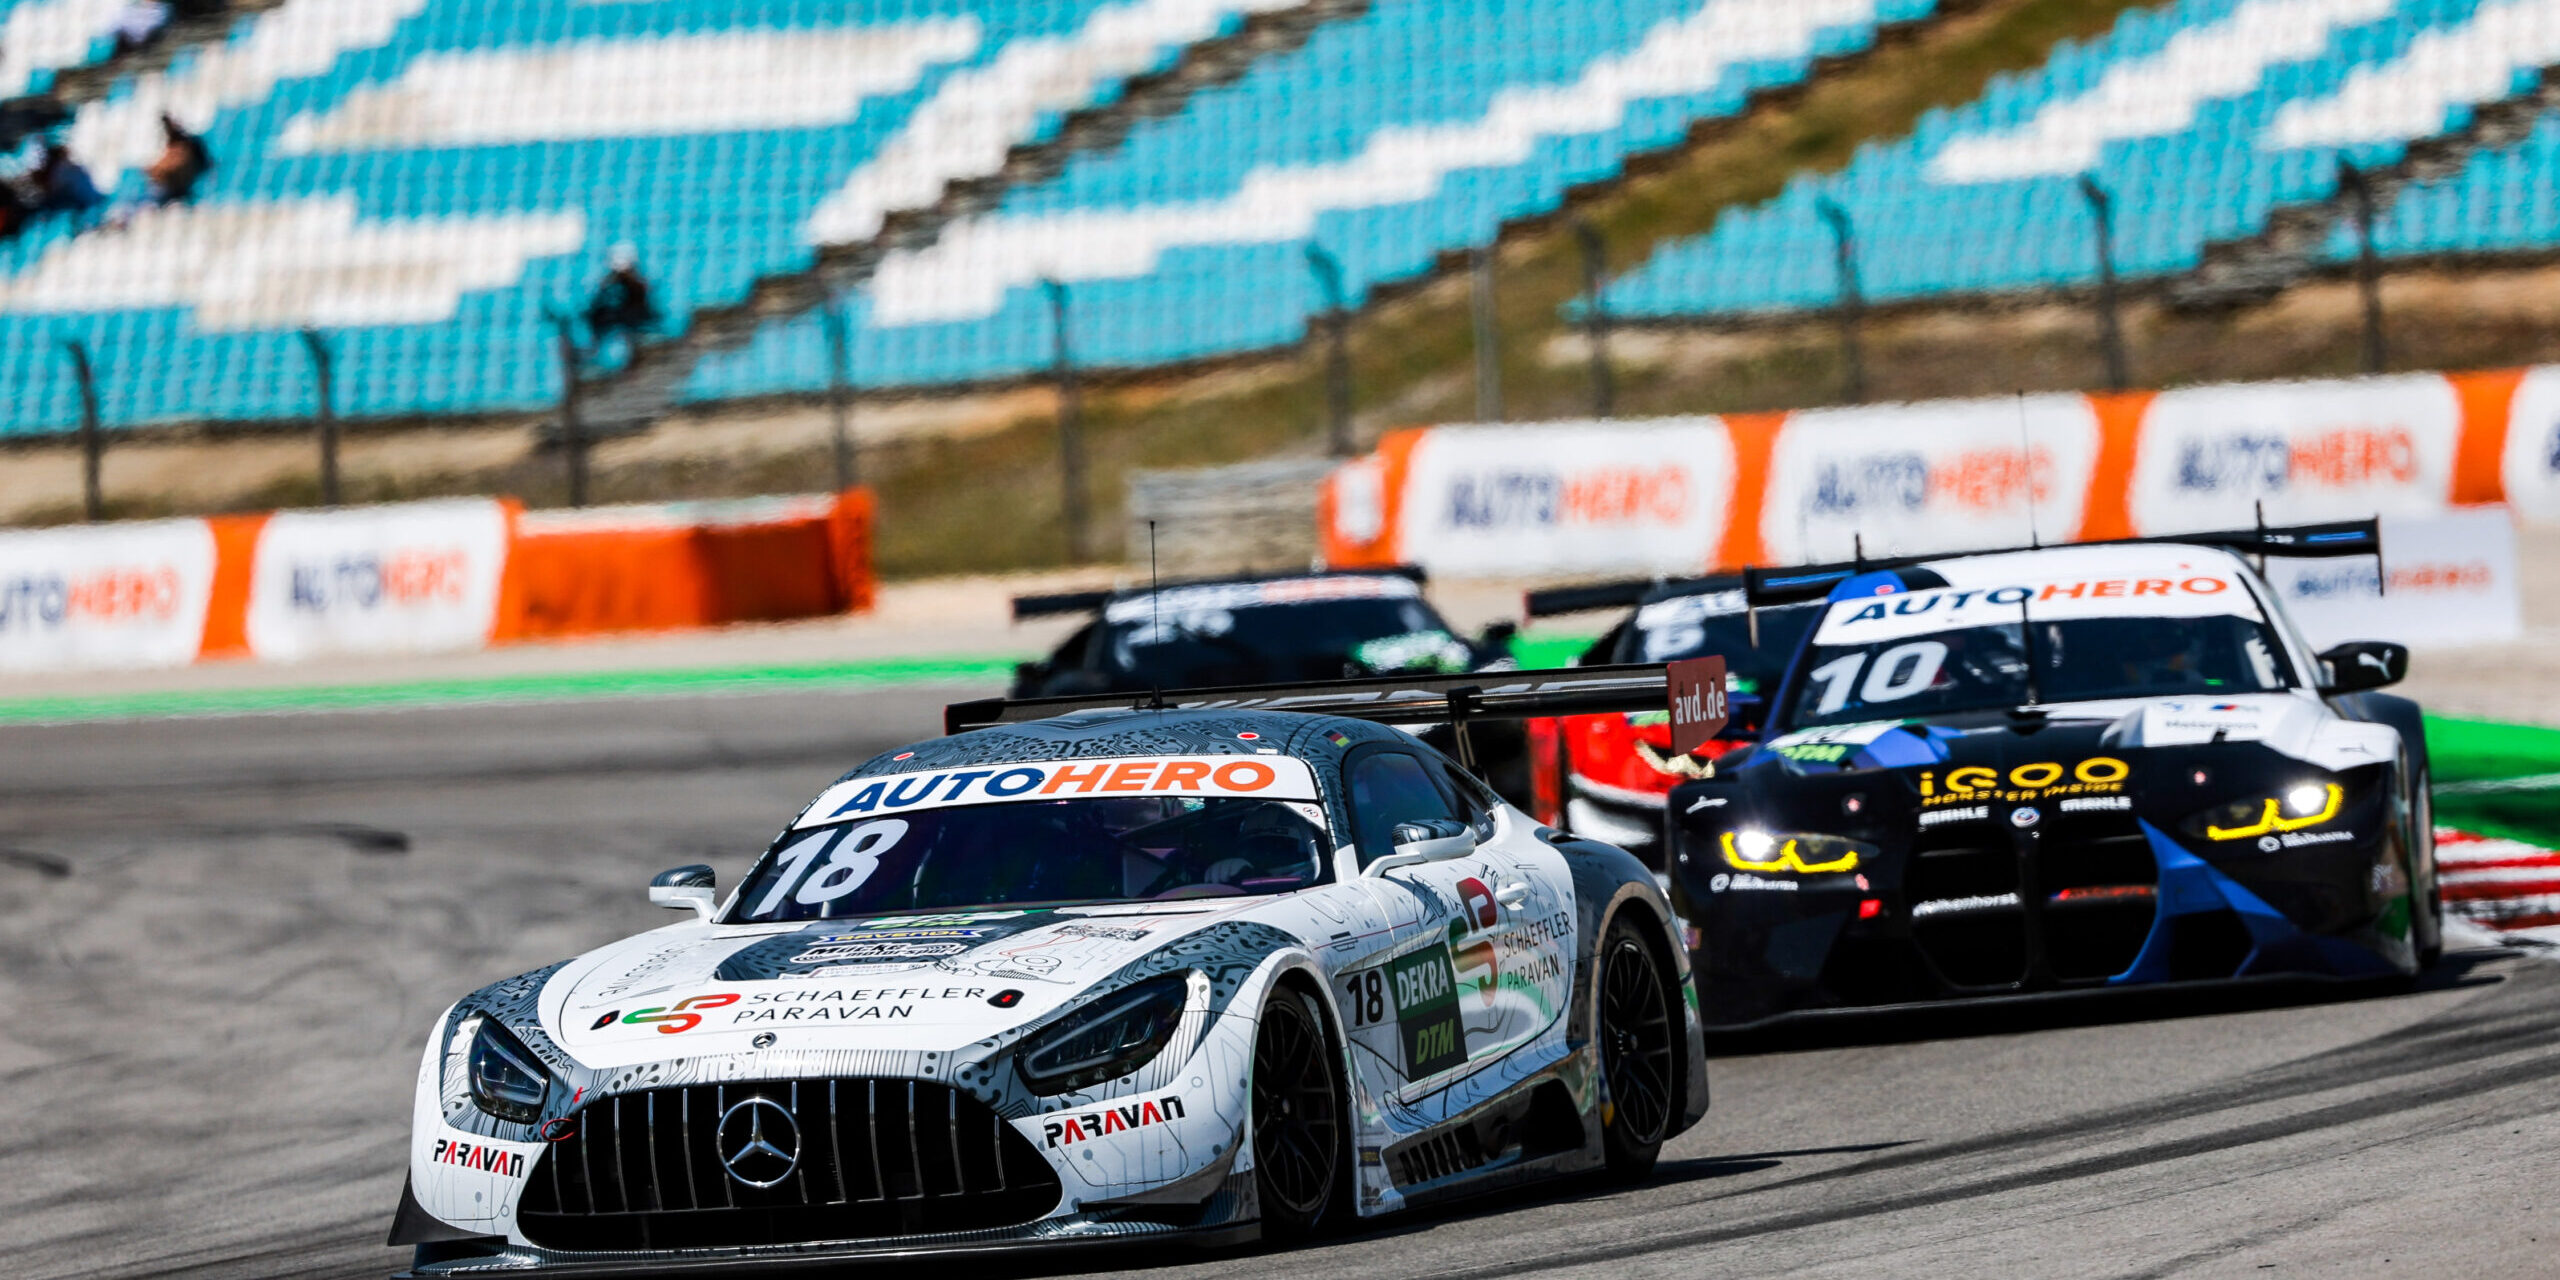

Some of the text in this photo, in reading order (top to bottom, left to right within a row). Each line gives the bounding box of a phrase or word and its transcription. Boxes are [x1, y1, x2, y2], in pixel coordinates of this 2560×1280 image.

[1841, 576, 2229, 626] AUTOHERO
[1810, 640, 1949, 716] 10
[1675, 681, 1725, 725] avd.de
[827, 760, 1275, 820] AUTOHERO
[750, 818, 909, 918] 18
[835, 930, 965, 942] RAVENOL
[1503, 910, 1574, 959] SCHAEFFLER
[747, 986, 986, 1006] SCHAEFFLER
[1396, 955, 1450, 1011] DEKRA
[1507, 954, 1560, 990] PARAVAN
[732, 1004, 914, 1025] PARAVAN
[1346, 970, 1384, 1027] 18
[1415, 1018, 1455, 1066] DTM
[1044, 1095, 1186, 1149] PARAVAN
[433, 1138, 525, 1179] PARAVAN
